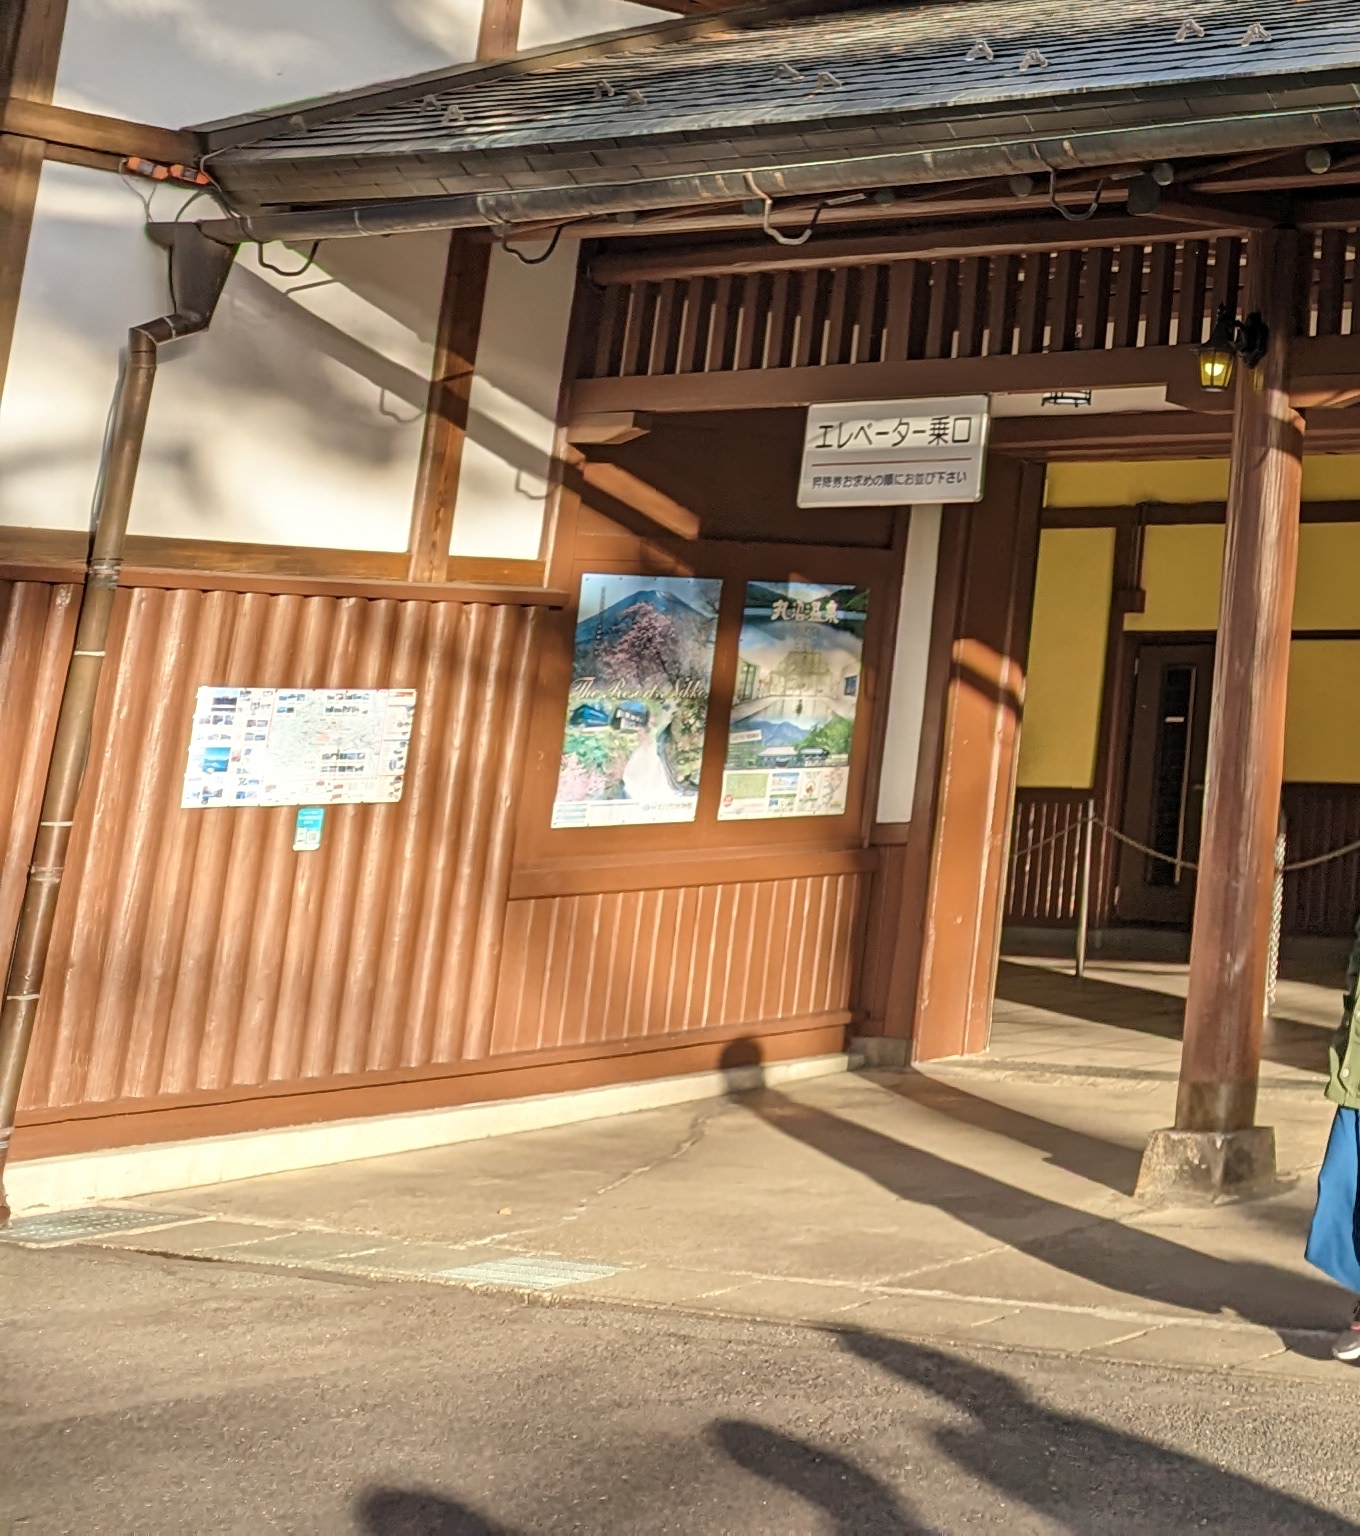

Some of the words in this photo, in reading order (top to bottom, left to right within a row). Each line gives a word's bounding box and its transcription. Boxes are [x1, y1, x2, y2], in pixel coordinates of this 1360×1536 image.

[814, 415, 972, 450] エレベーター乗口
